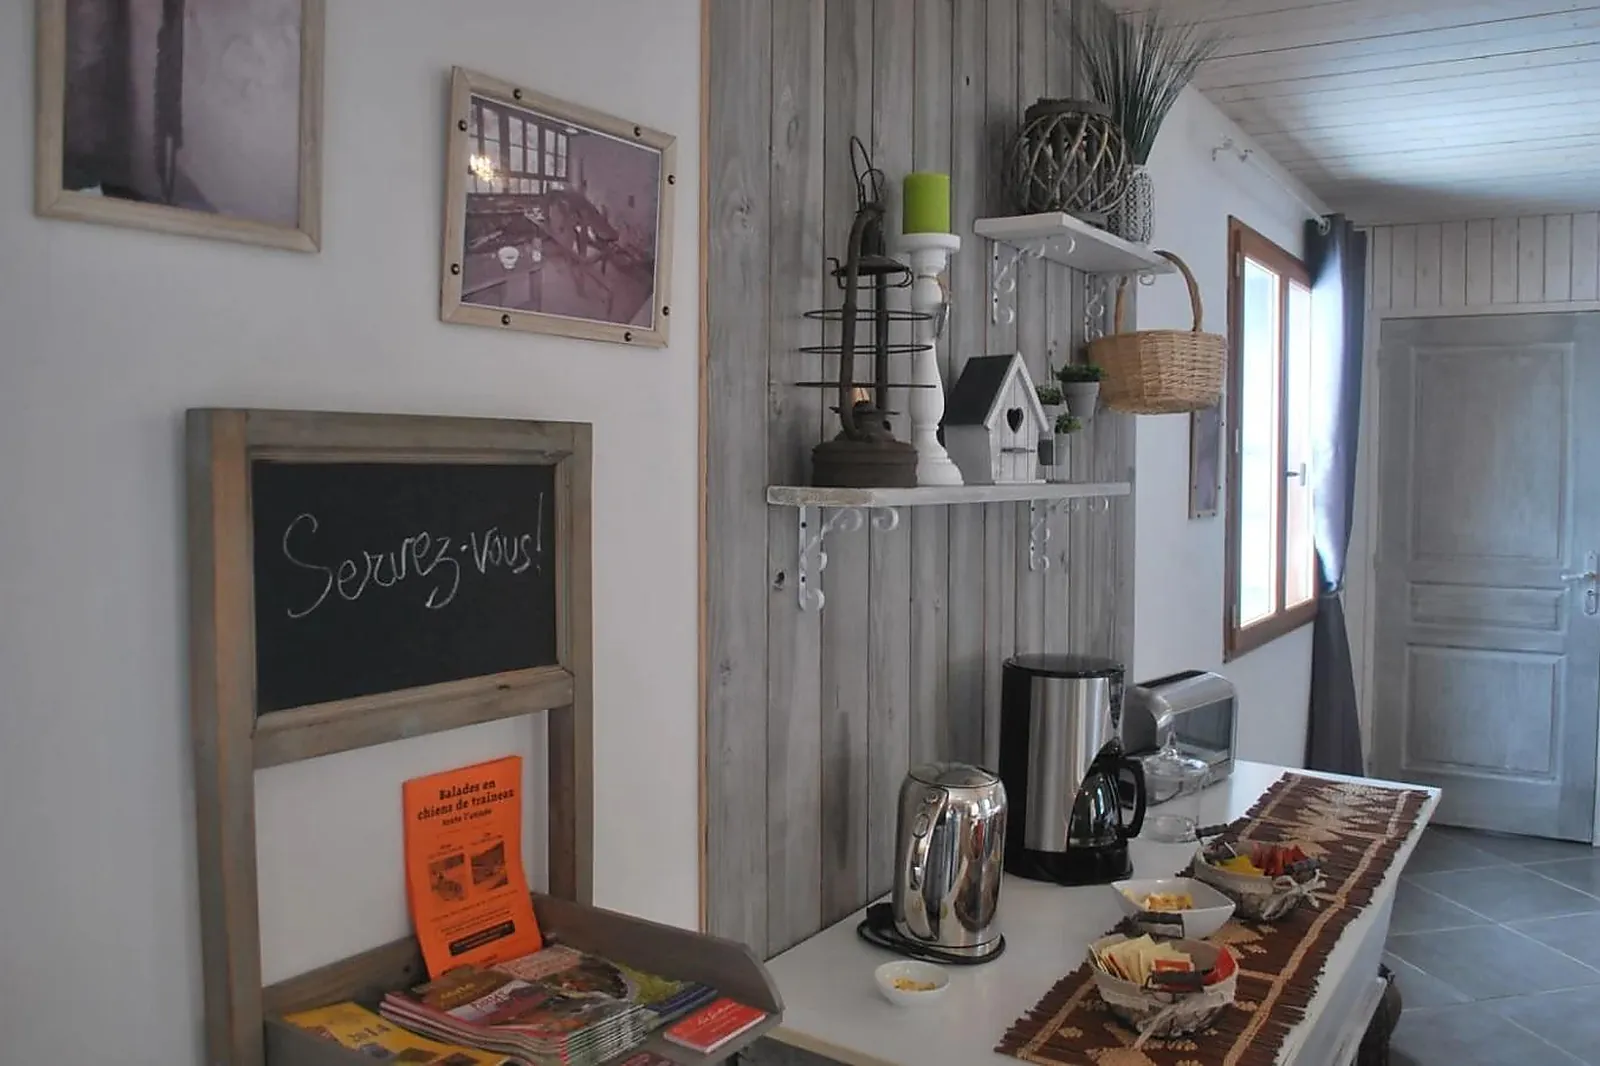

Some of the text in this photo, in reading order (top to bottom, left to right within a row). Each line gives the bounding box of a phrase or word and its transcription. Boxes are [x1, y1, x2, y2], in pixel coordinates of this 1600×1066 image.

[439, 780, 496, 800] Balades en
[417, 803, 453, 820] chiens
[456, 798, 469, 811] de
